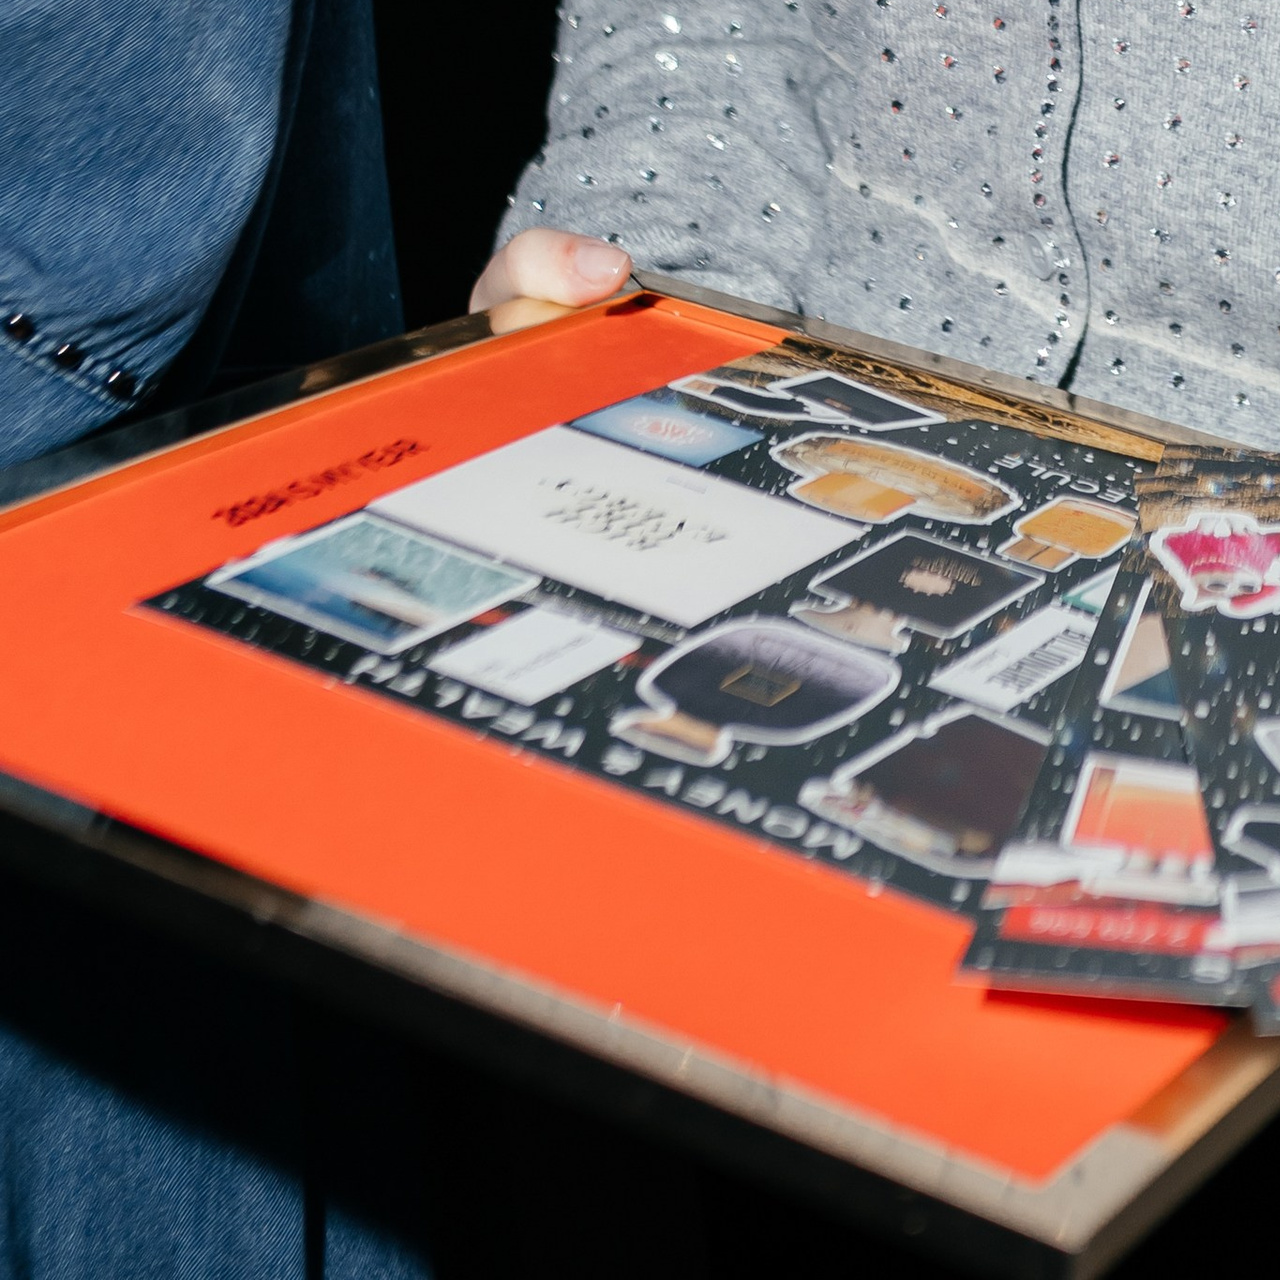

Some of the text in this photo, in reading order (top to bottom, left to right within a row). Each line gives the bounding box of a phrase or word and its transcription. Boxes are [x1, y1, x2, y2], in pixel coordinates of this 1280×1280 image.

[993, 454, 1136, 503] ECULE
[347, 652, 585, 758] WEALTH
[601, 741, 644, 776] &
[643, 766, 862, 859] MONEY
